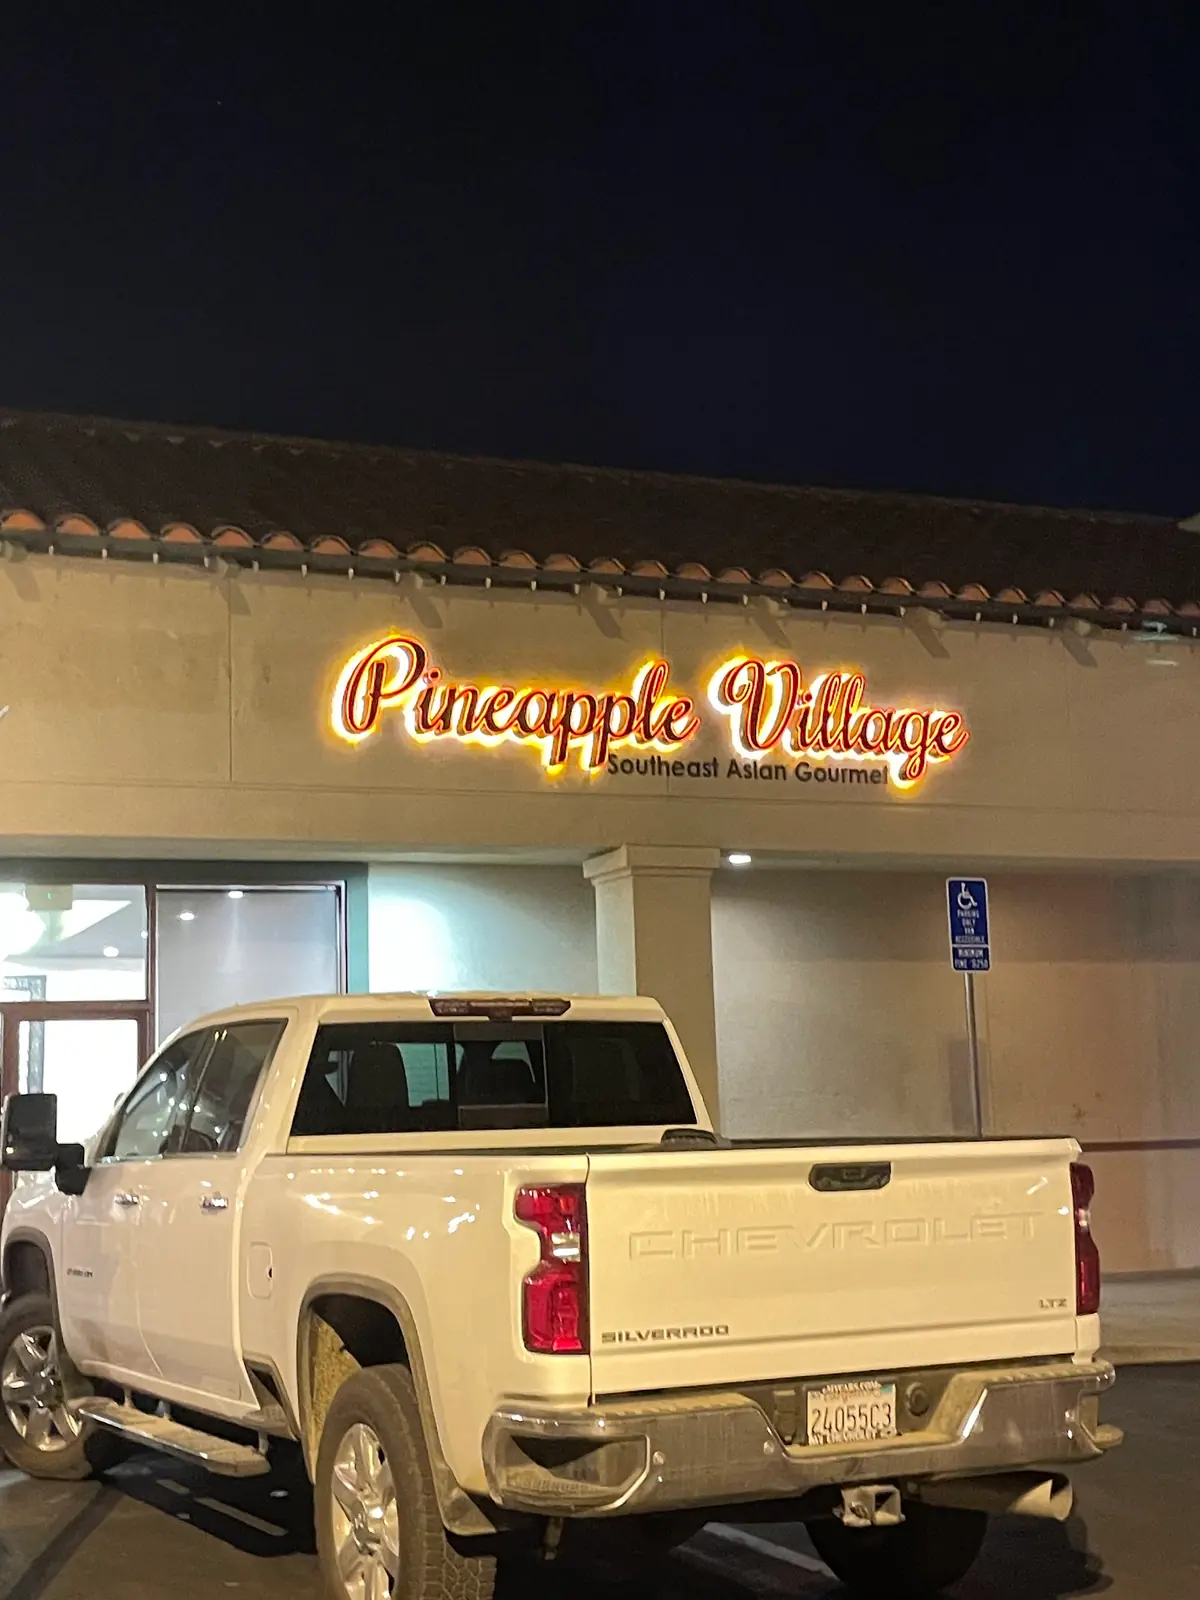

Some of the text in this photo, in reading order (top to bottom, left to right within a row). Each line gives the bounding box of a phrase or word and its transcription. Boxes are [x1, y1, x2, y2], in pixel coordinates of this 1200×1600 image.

[342, 636, 969, 779] Pineapple Village
[608, 754, 719, 778] Southeast
[726, 759, 787, 781] Asian
[629, 1211, 1043, 1261] CHEVROLET
[1039, 1297, 1067, 1309] LTZ
[601, 1325, 730, 1343] SILVERADO
[812, 1403, 891, 1433] 24055C3
